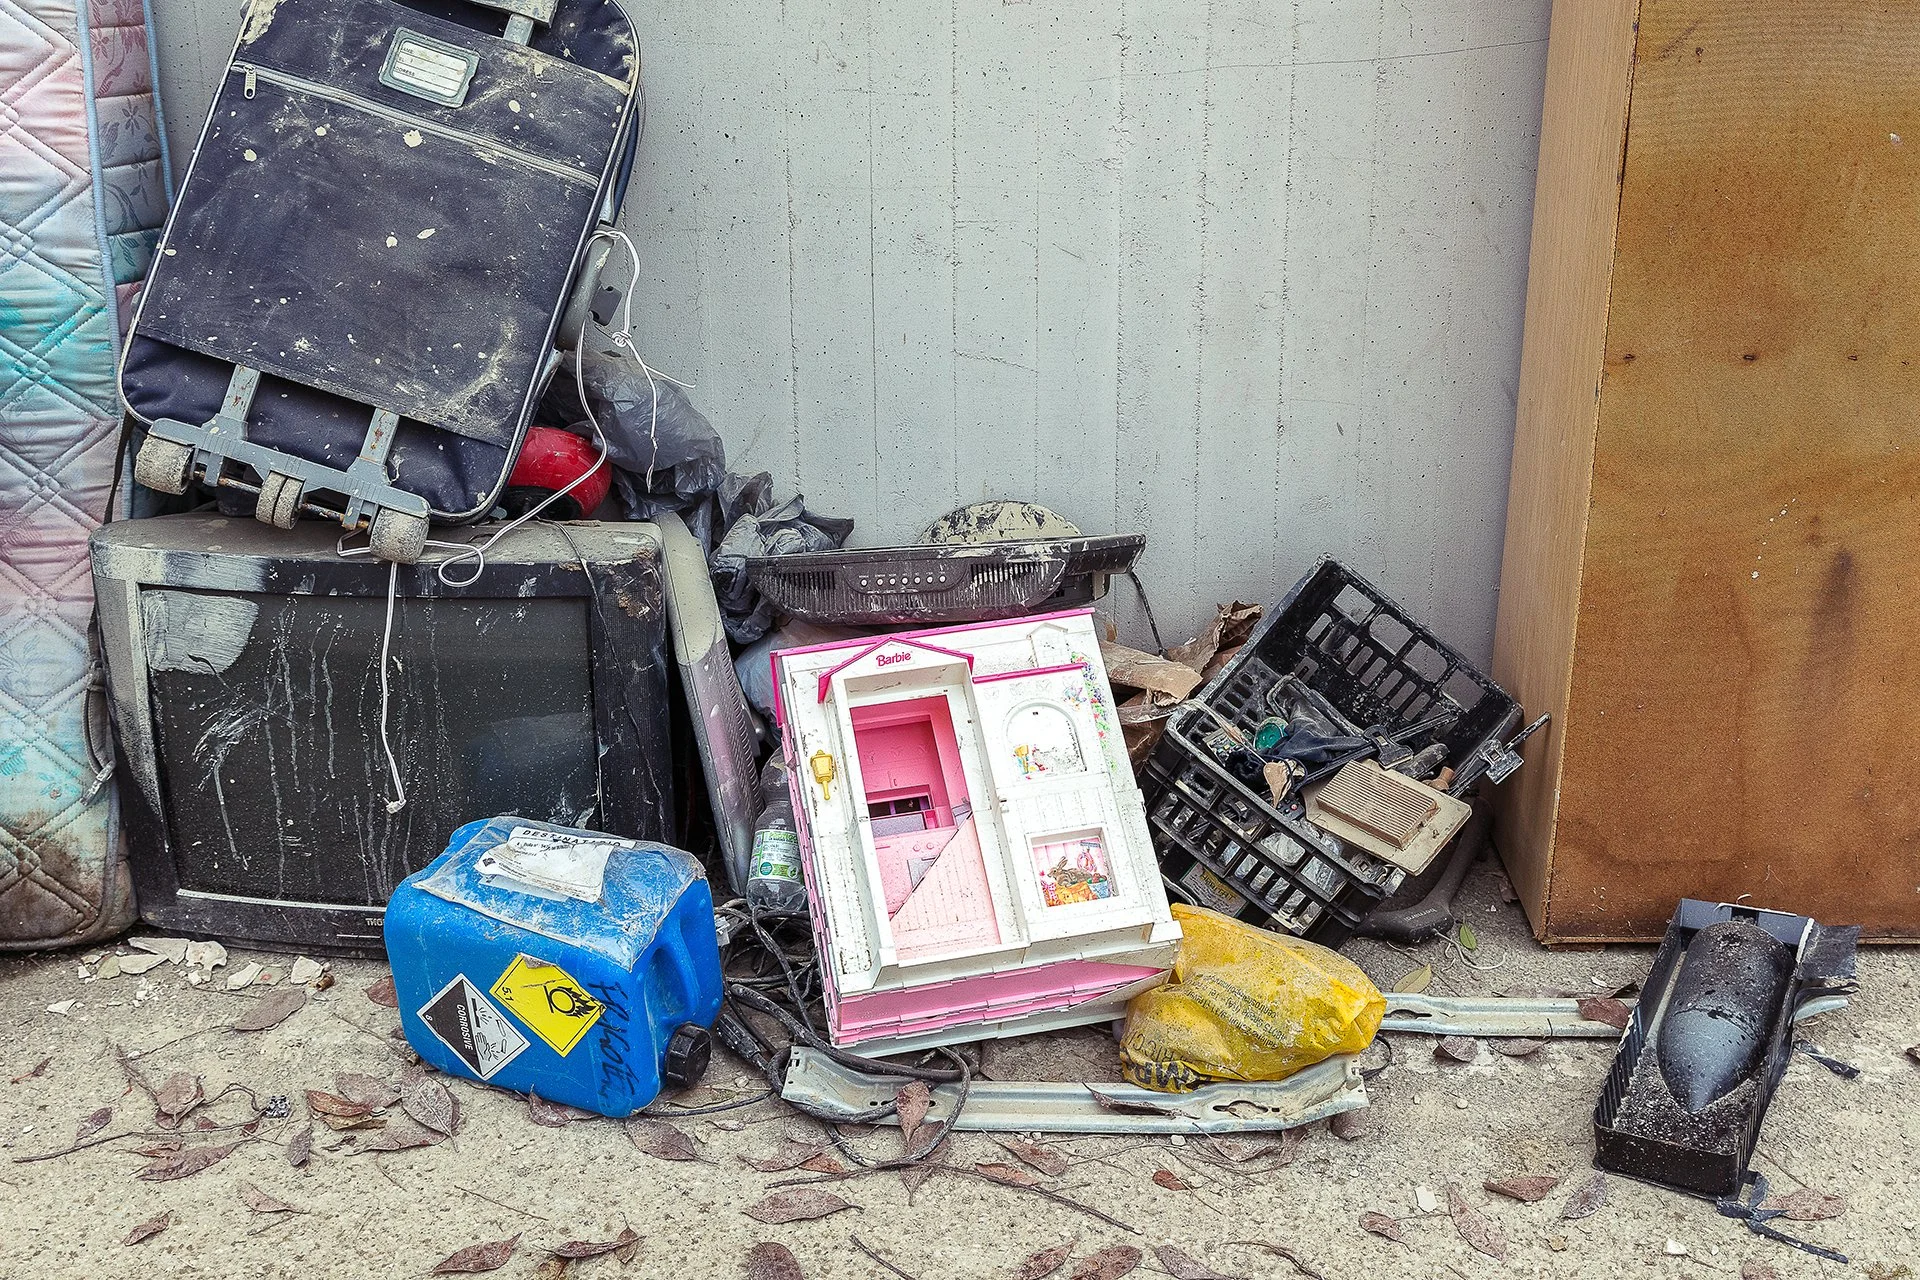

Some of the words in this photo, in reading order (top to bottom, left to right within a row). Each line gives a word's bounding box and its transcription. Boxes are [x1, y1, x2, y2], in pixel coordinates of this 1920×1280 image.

[876, 652, 911, 667] Barbie
[522, 829, 621, 847] DESTINATIO
[365, 917, 384, 926] THO
[502, 986, 514, 1001] 5.1
[456, 1004, 473, 1050] CORROSIVE
